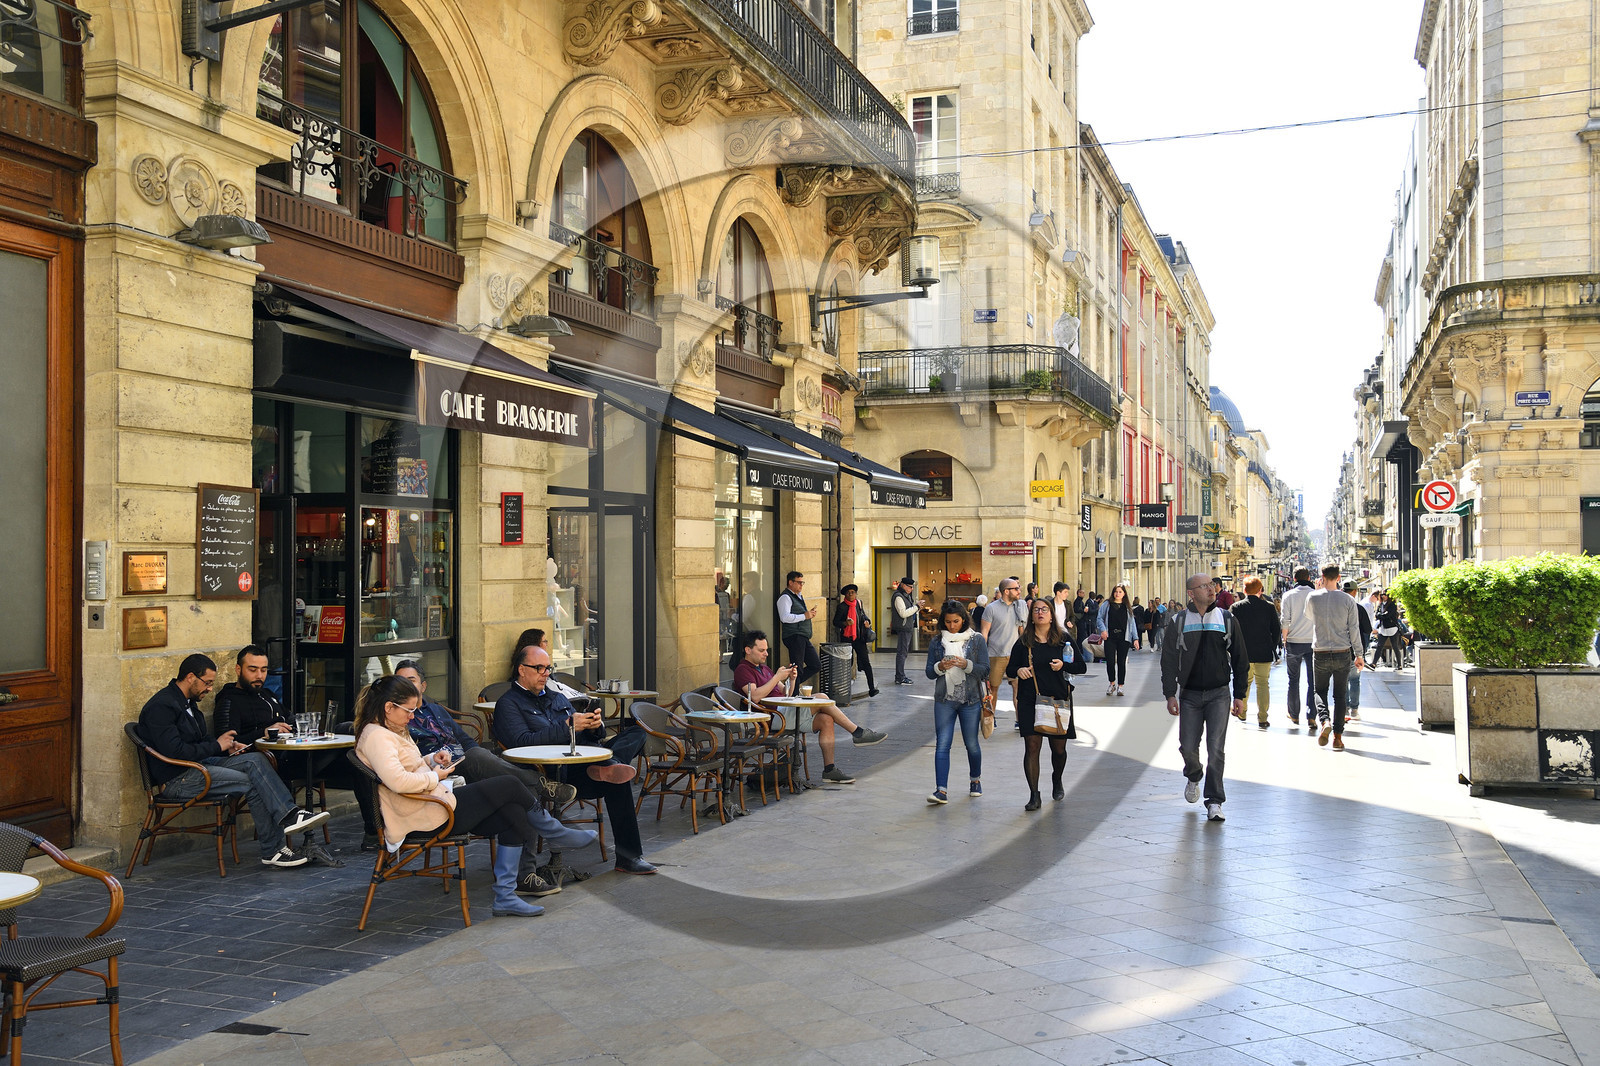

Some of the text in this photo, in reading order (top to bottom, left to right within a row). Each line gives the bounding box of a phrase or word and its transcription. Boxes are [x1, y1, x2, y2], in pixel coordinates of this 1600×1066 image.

[440, 389, 579, 437] CAFÉ BRASSERIE
[772, 472, 813, 490] CASE FOR YOU
[1032, 484, 1063, 493] BOCAGE
[885, 492, 913, 506] CASE FOR YOU
[1082, 505, 1091, 531] Etam
[893, 525, 963, 541] BOCAGE
